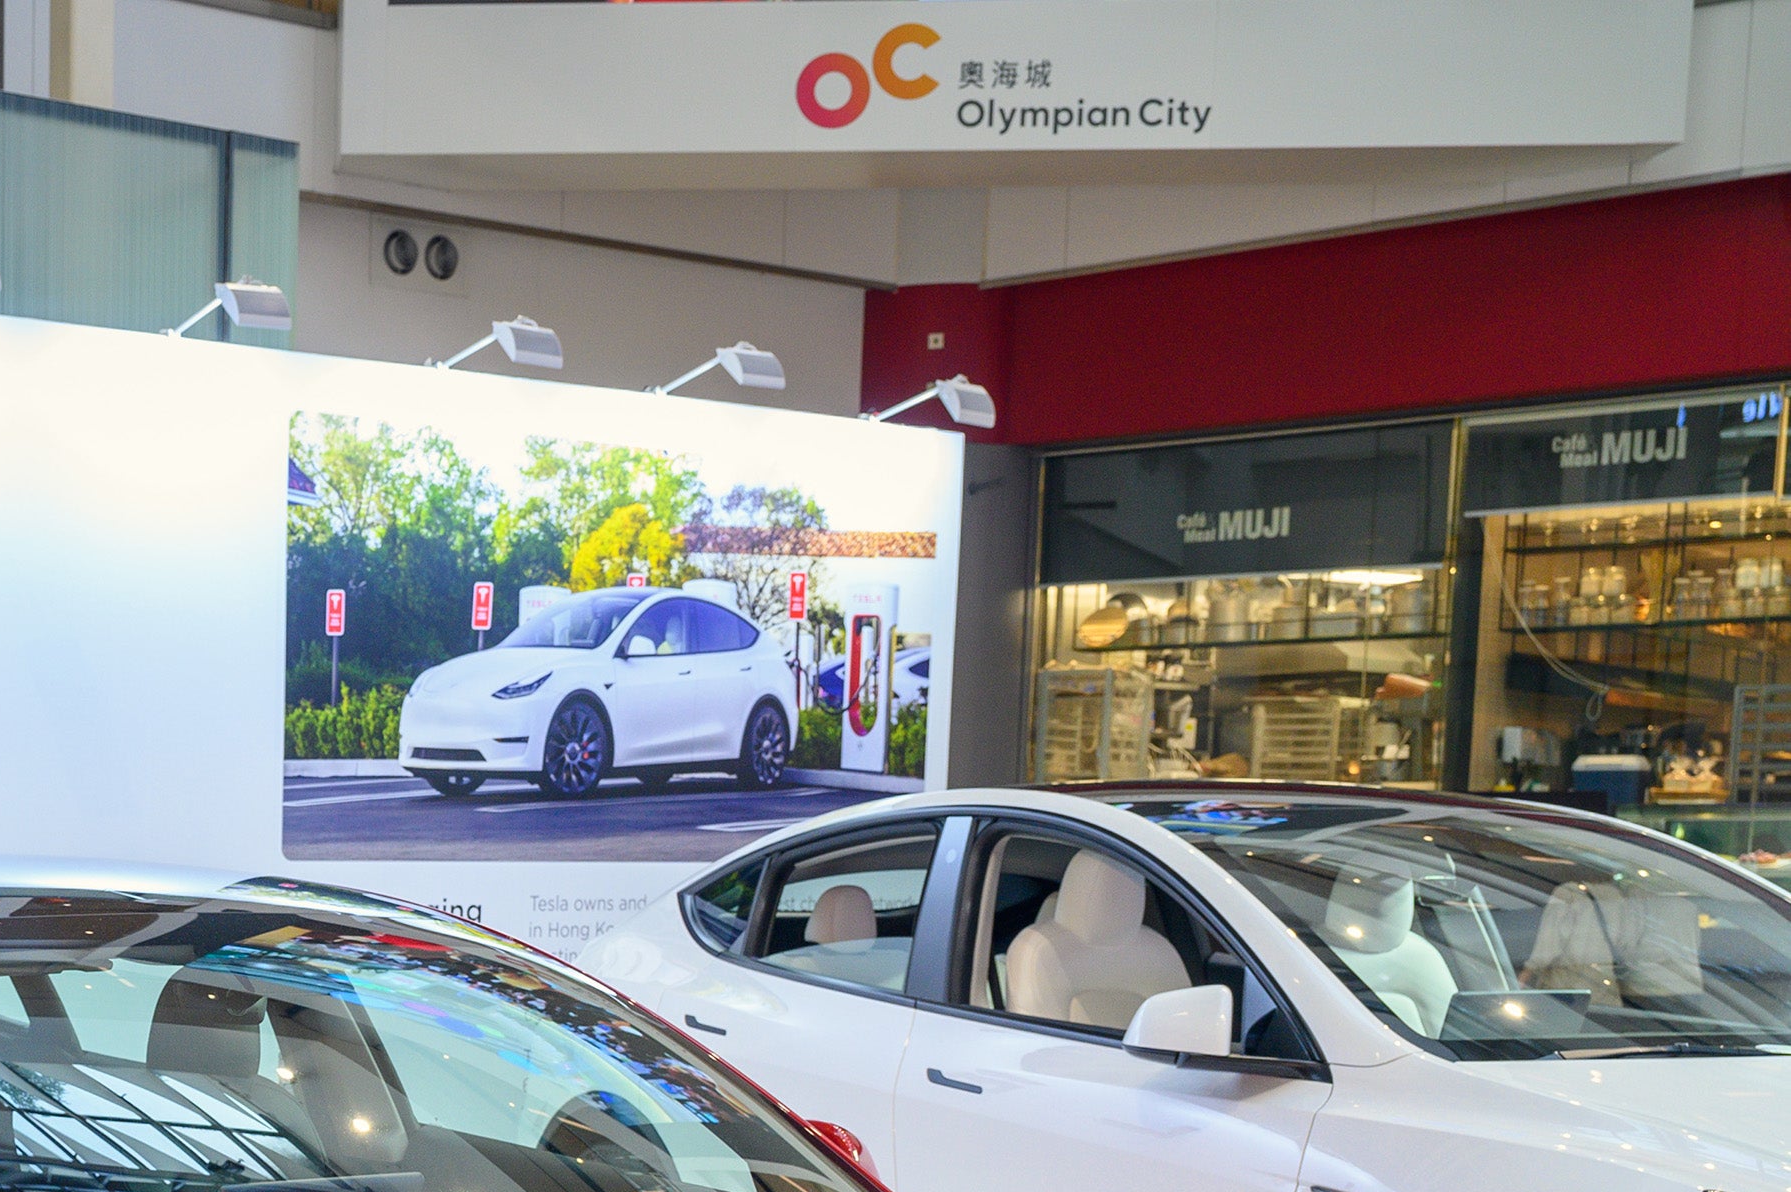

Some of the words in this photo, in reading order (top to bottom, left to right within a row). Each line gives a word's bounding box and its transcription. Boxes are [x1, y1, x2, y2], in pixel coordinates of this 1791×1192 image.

[958, 60, 1053, 89] 奧海城
[957, 98, 1131, 135] Olympian
[1139, 98, 1212, 133] City
[1600, 426, 1688, 466] MUJI
[1218, 506, 1291, 541] MUJI
[530, 895, 568, 912] Tesla
[573, 899, 614, 912] owns
[618, 894, 647, 912] and
[528, 922, 542, 938] in
[548, 922, 589, 941] Hong
